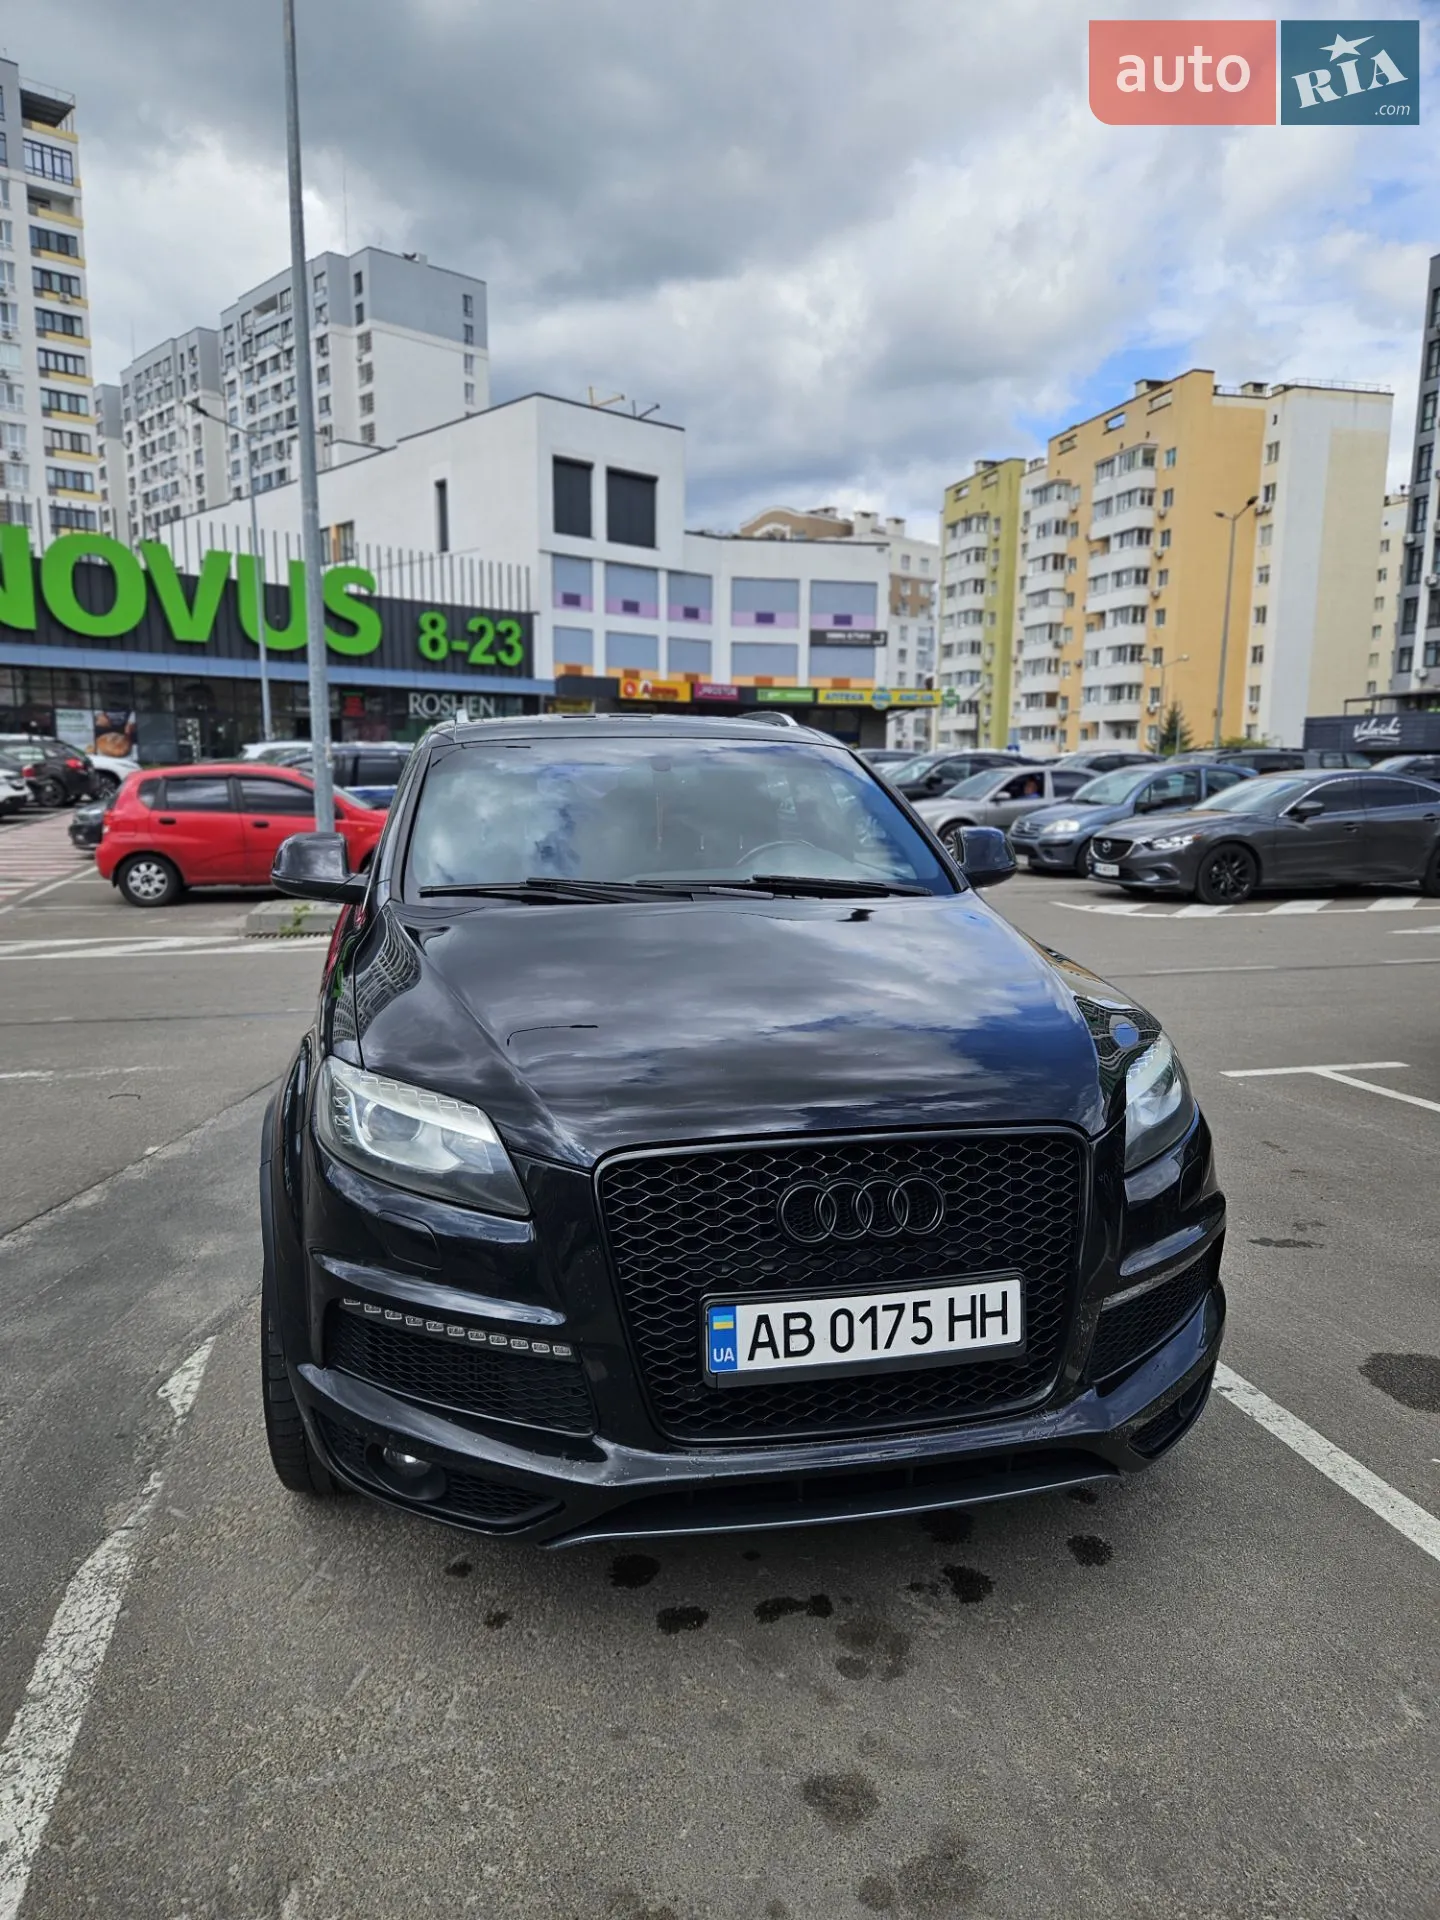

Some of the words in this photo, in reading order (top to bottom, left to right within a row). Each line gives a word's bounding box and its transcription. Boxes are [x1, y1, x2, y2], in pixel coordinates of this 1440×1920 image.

[418, 610, 524, 667] 8-23
[408, 692, 496, 720] ROSHEN
[747, 1312, 816, 1362] AB
[829, 1299, 933, 1354] 0175
[947, 1290, 1008, 1342] HH
[713, 1346, 735, 1363] UA
